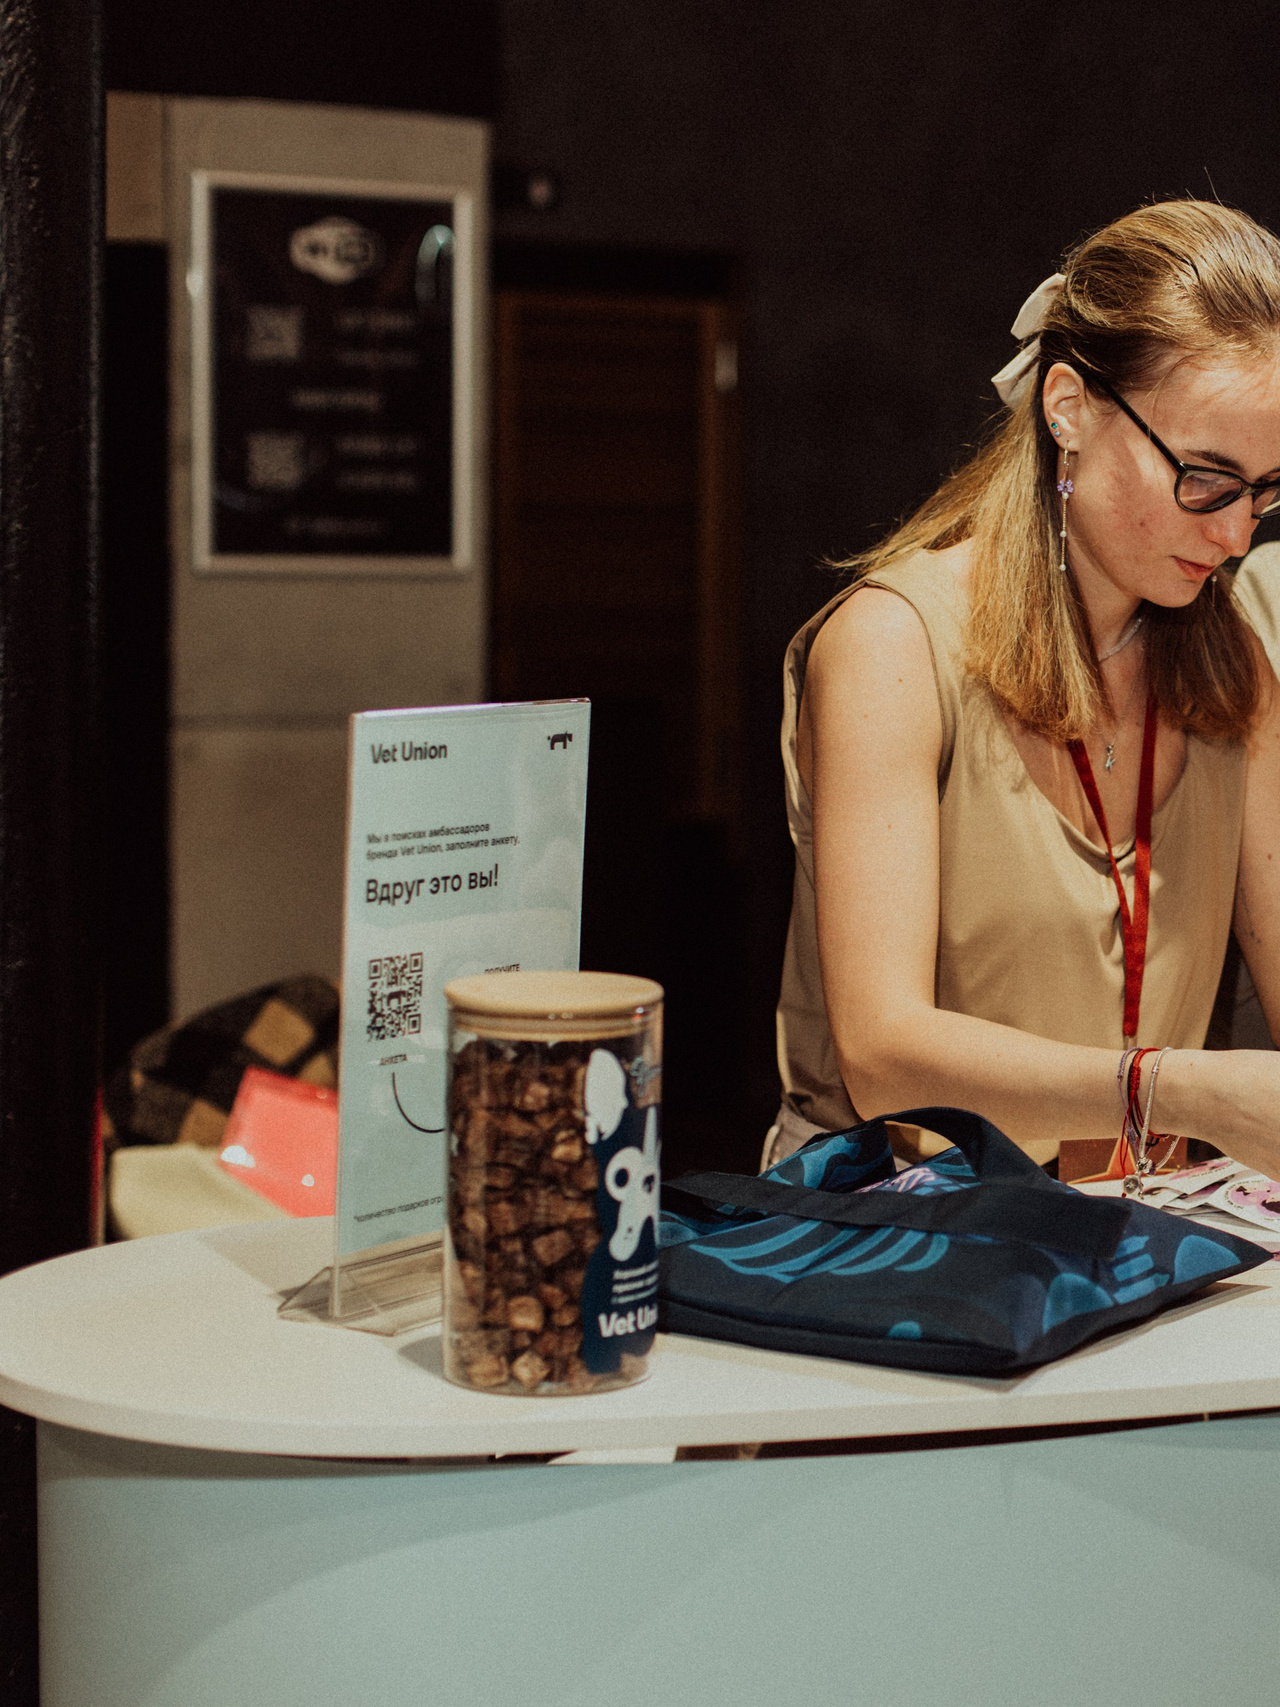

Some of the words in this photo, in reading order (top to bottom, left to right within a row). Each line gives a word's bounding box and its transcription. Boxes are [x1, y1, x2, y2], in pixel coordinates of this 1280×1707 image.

[371, 743, 397, 764] Vet
[402, 741, 448, 761] Union
[367, 833, 382, 844] Мы
[392, 830, 427, 841] поисках
[428, 822, 490, 838] амбассадоров
[366, 849, 398, 861] бренда
[400, 845, 415, 856] Vet
[417, 843, 443, 855] Union,
[445, 836, 490, 852] заполните
[366, 878, 425, 906] Вдруг
[429, 874, 463, 895] это
[468, 863, 499, 890] вы!
[379, 1054, 409, 1066] АНКЕТА
[398, 1199, 429, 1213] подарков
[598, 1310, 636, 1338] Vet
[637, 1302, 658, 1330] Uni
